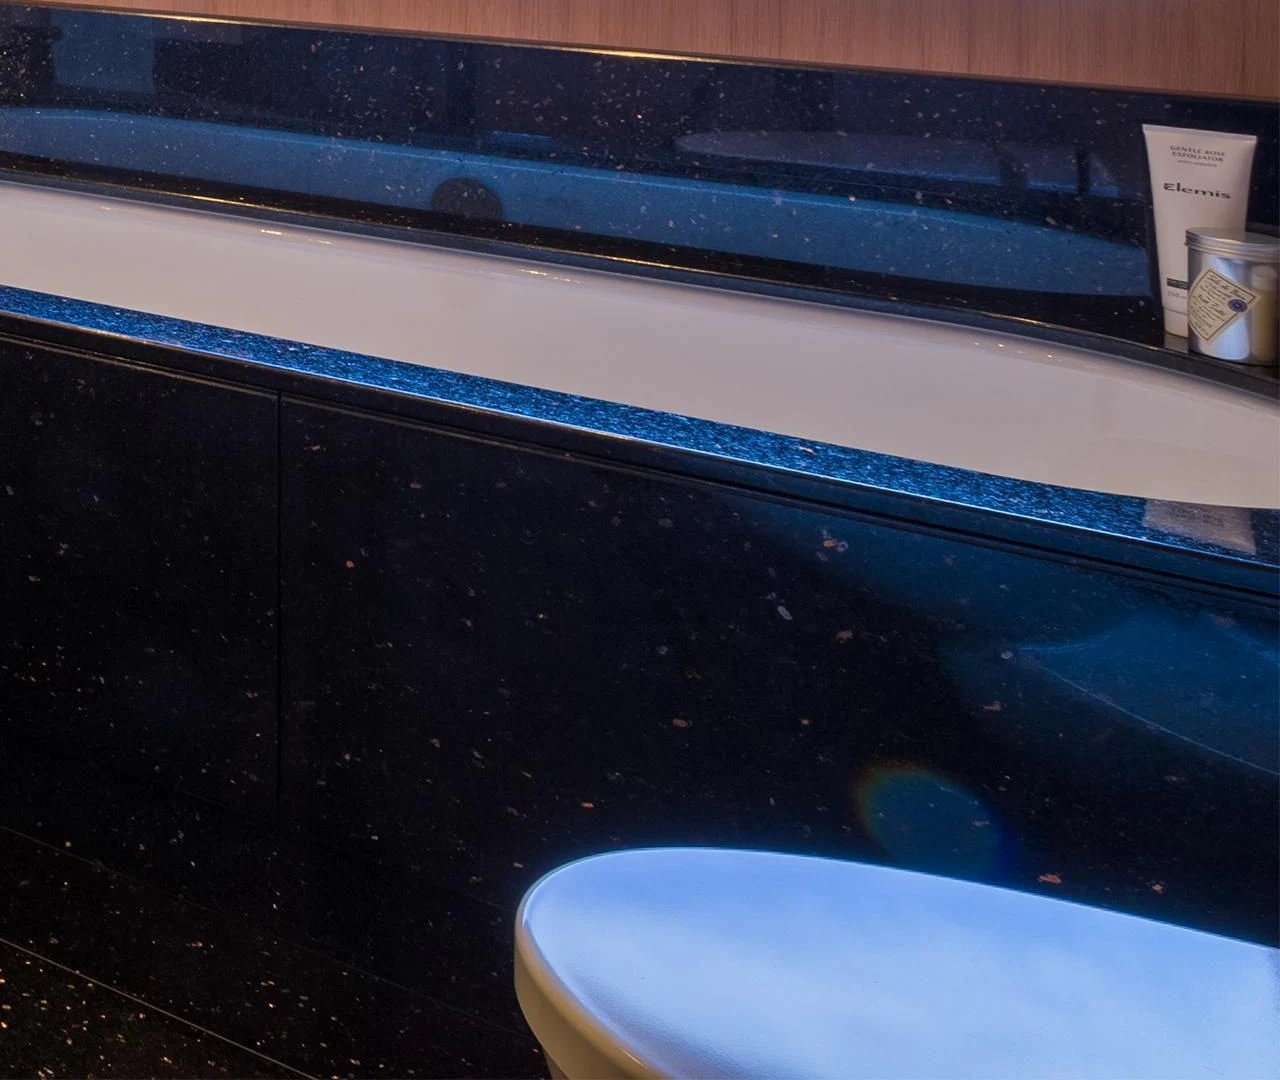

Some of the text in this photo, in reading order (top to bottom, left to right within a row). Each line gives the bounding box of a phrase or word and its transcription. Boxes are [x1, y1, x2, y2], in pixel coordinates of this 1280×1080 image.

[1170, 145, 1201, 154] GENTLE
[1172, 151, 1223, 162] EXFOLIATOR
[1163, 182, 1231, 199] Elemis
